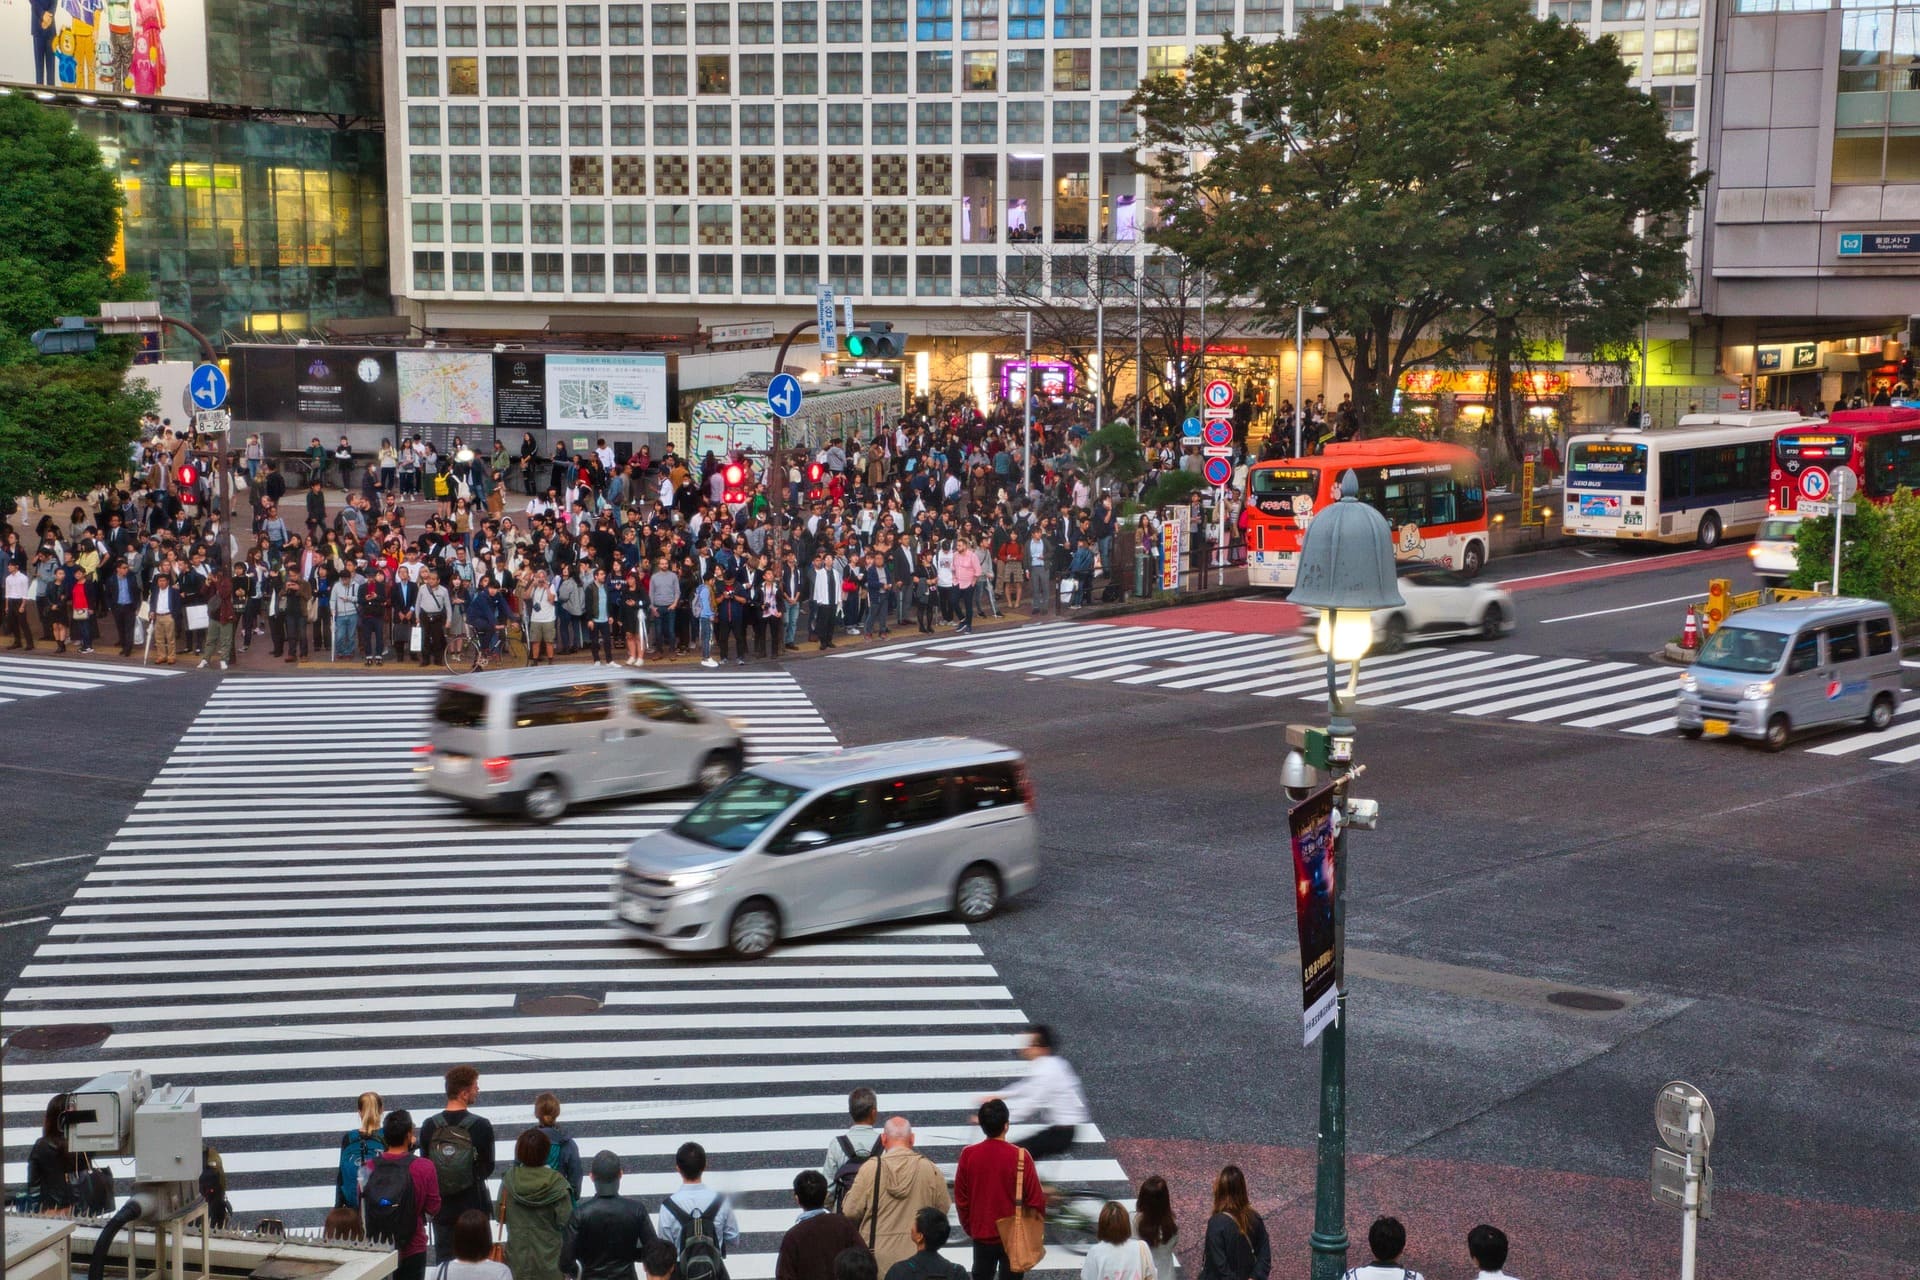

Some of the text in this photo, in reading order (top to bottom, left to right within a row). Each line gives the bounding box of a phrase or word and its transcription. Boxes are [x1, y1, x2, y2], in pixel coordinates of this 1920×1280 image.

[1875, 236, 1911, 244] 東京メトロ
